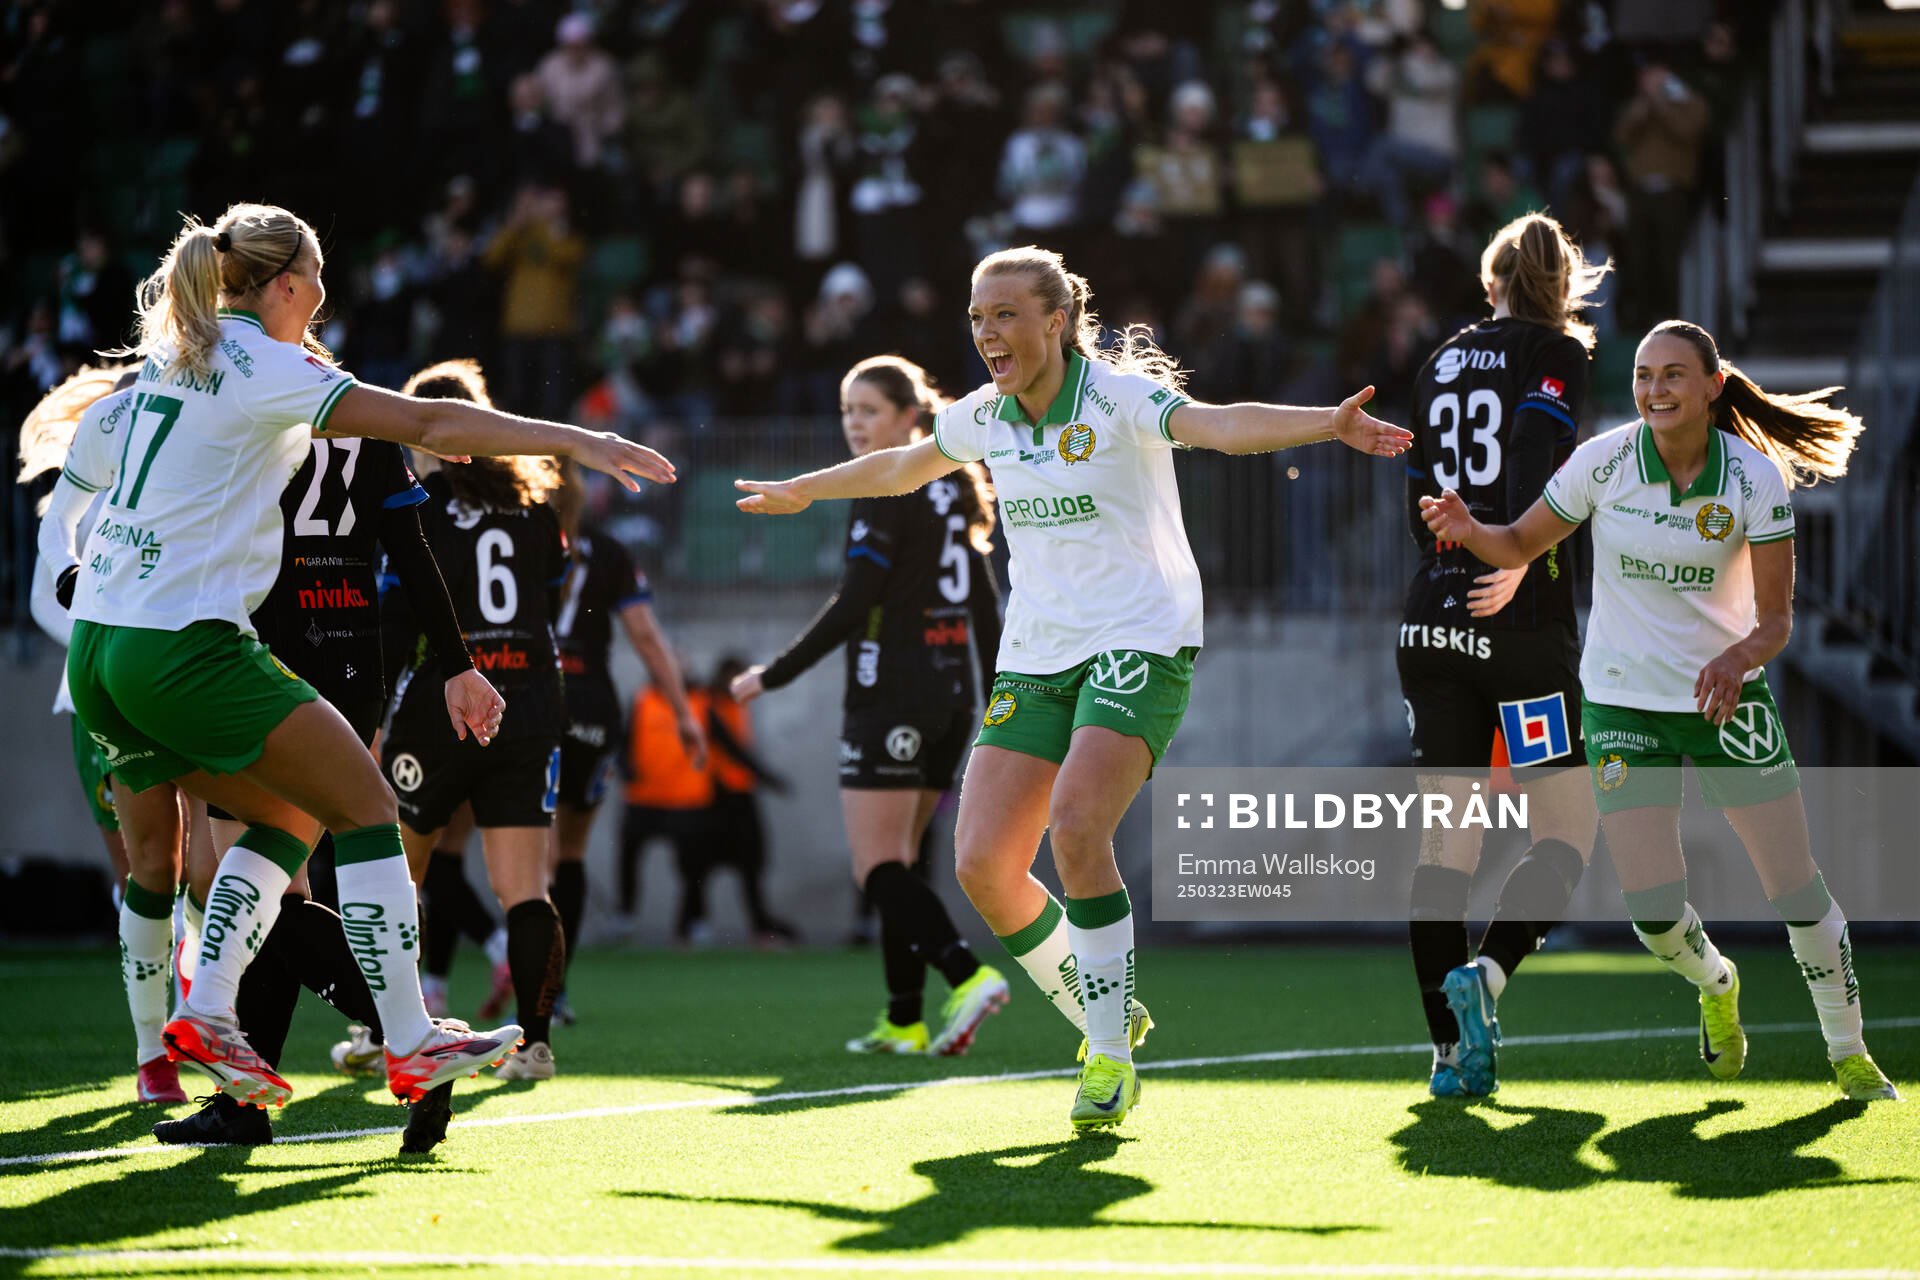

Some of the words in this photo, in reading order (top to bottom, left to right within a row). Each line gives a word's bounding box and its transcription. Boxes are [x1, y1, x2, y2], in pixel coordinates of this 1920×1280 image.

[1460, 348, 1506, 370] VIDA
[109, 393, 184, 511] 17
[1428, 389, 1503, 490] 33
[1592, 437, 1634, 484] Convini
[293, 437, 362, 537] 27
[1004, 494, 1097, 520] PROJOB
[1613, 504, 1643, 517] CRAFT
[1669, 514, 1694, 525] INTER
[1667, 521, 1692, 532] SPORT
[939, 514, 970, 604] 5
[475, 528, 518, 624] 6
[1672, 584, 1712, 593] WORKWEAR
[326, 630, 353, 638] VINGA
[1094, 697, 1128, 713] CRAFT
[1591, 731, 1658, 749] BOSPHORUS
[201, 874, 260, 962] Clinton
[342, 902, 388, 992] Clinton
